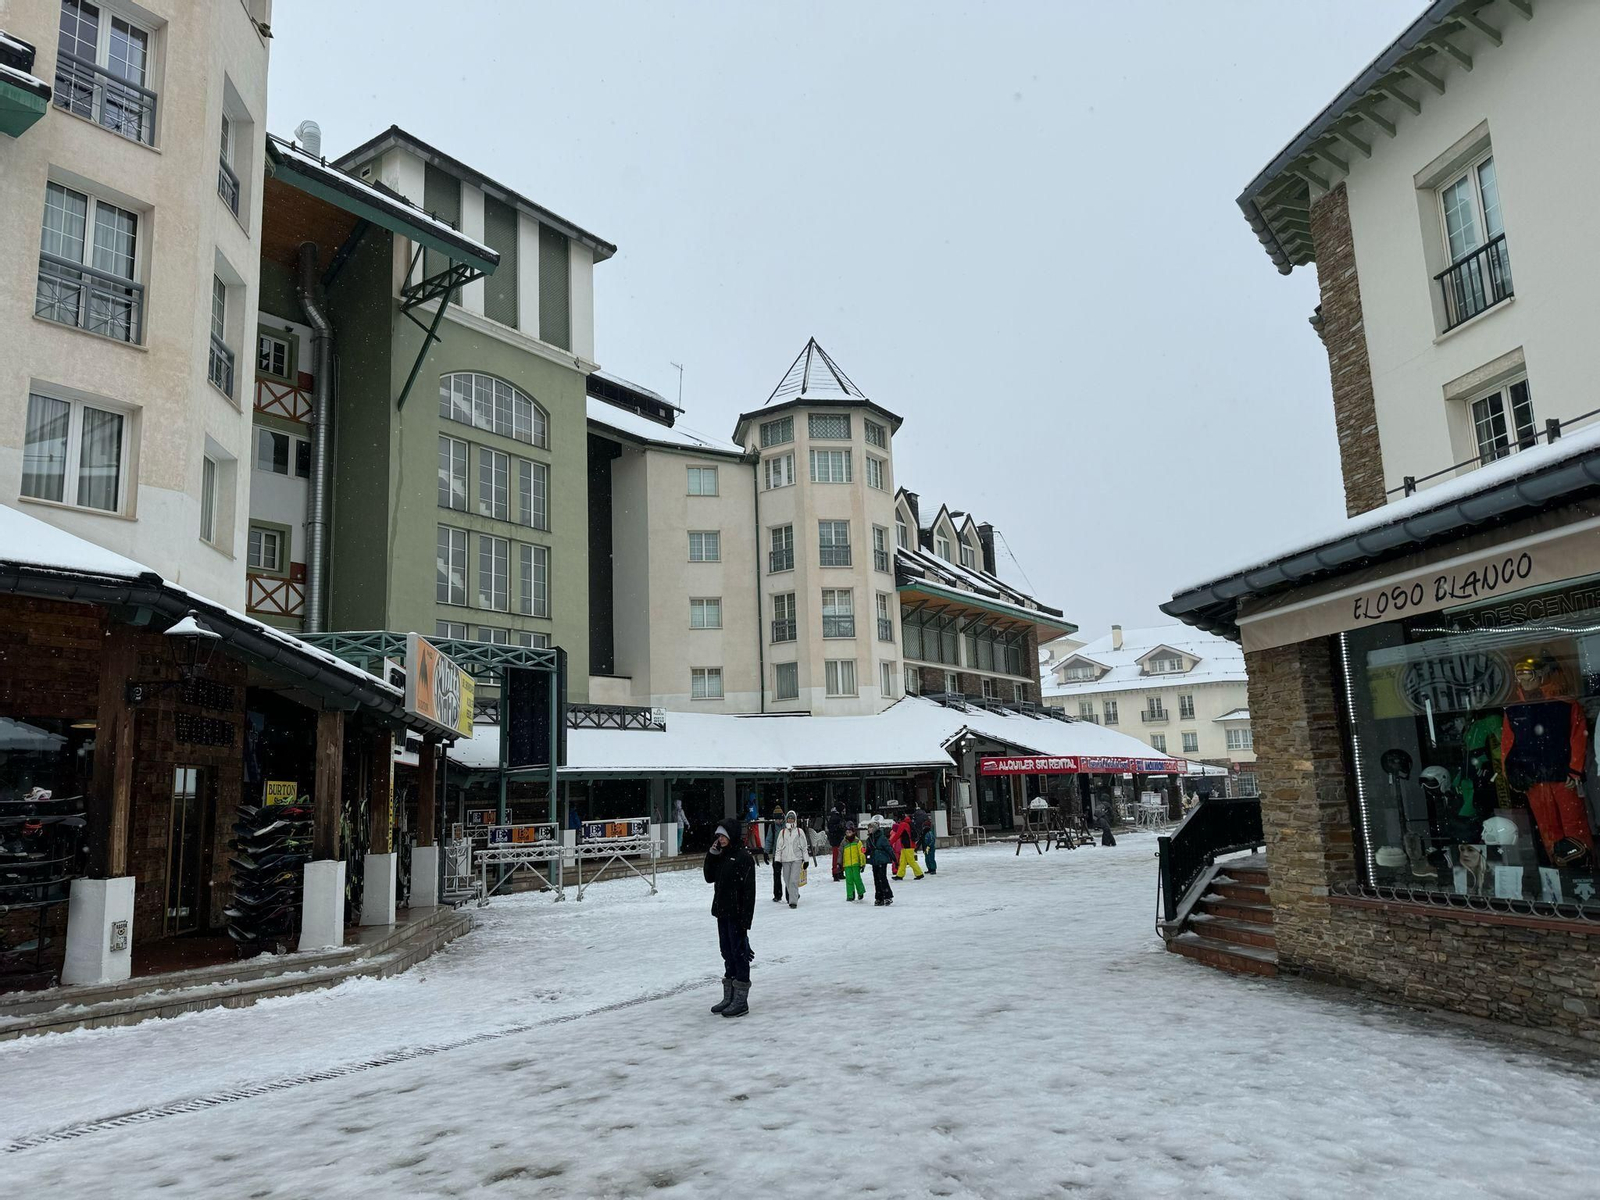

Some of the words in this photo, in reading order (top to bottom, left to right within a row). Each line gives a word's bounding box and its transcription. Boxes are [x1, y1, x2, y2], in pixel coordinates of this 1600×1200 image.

[1434, 552, 1532, 603] BLANCO
[998, 759, 1035, 771] ALQUILER
[1035, 759, 1049, 769] SKI
[1049, 758, 1077, 769] RENTAL
[268, 783, 297, 796] BURTON
